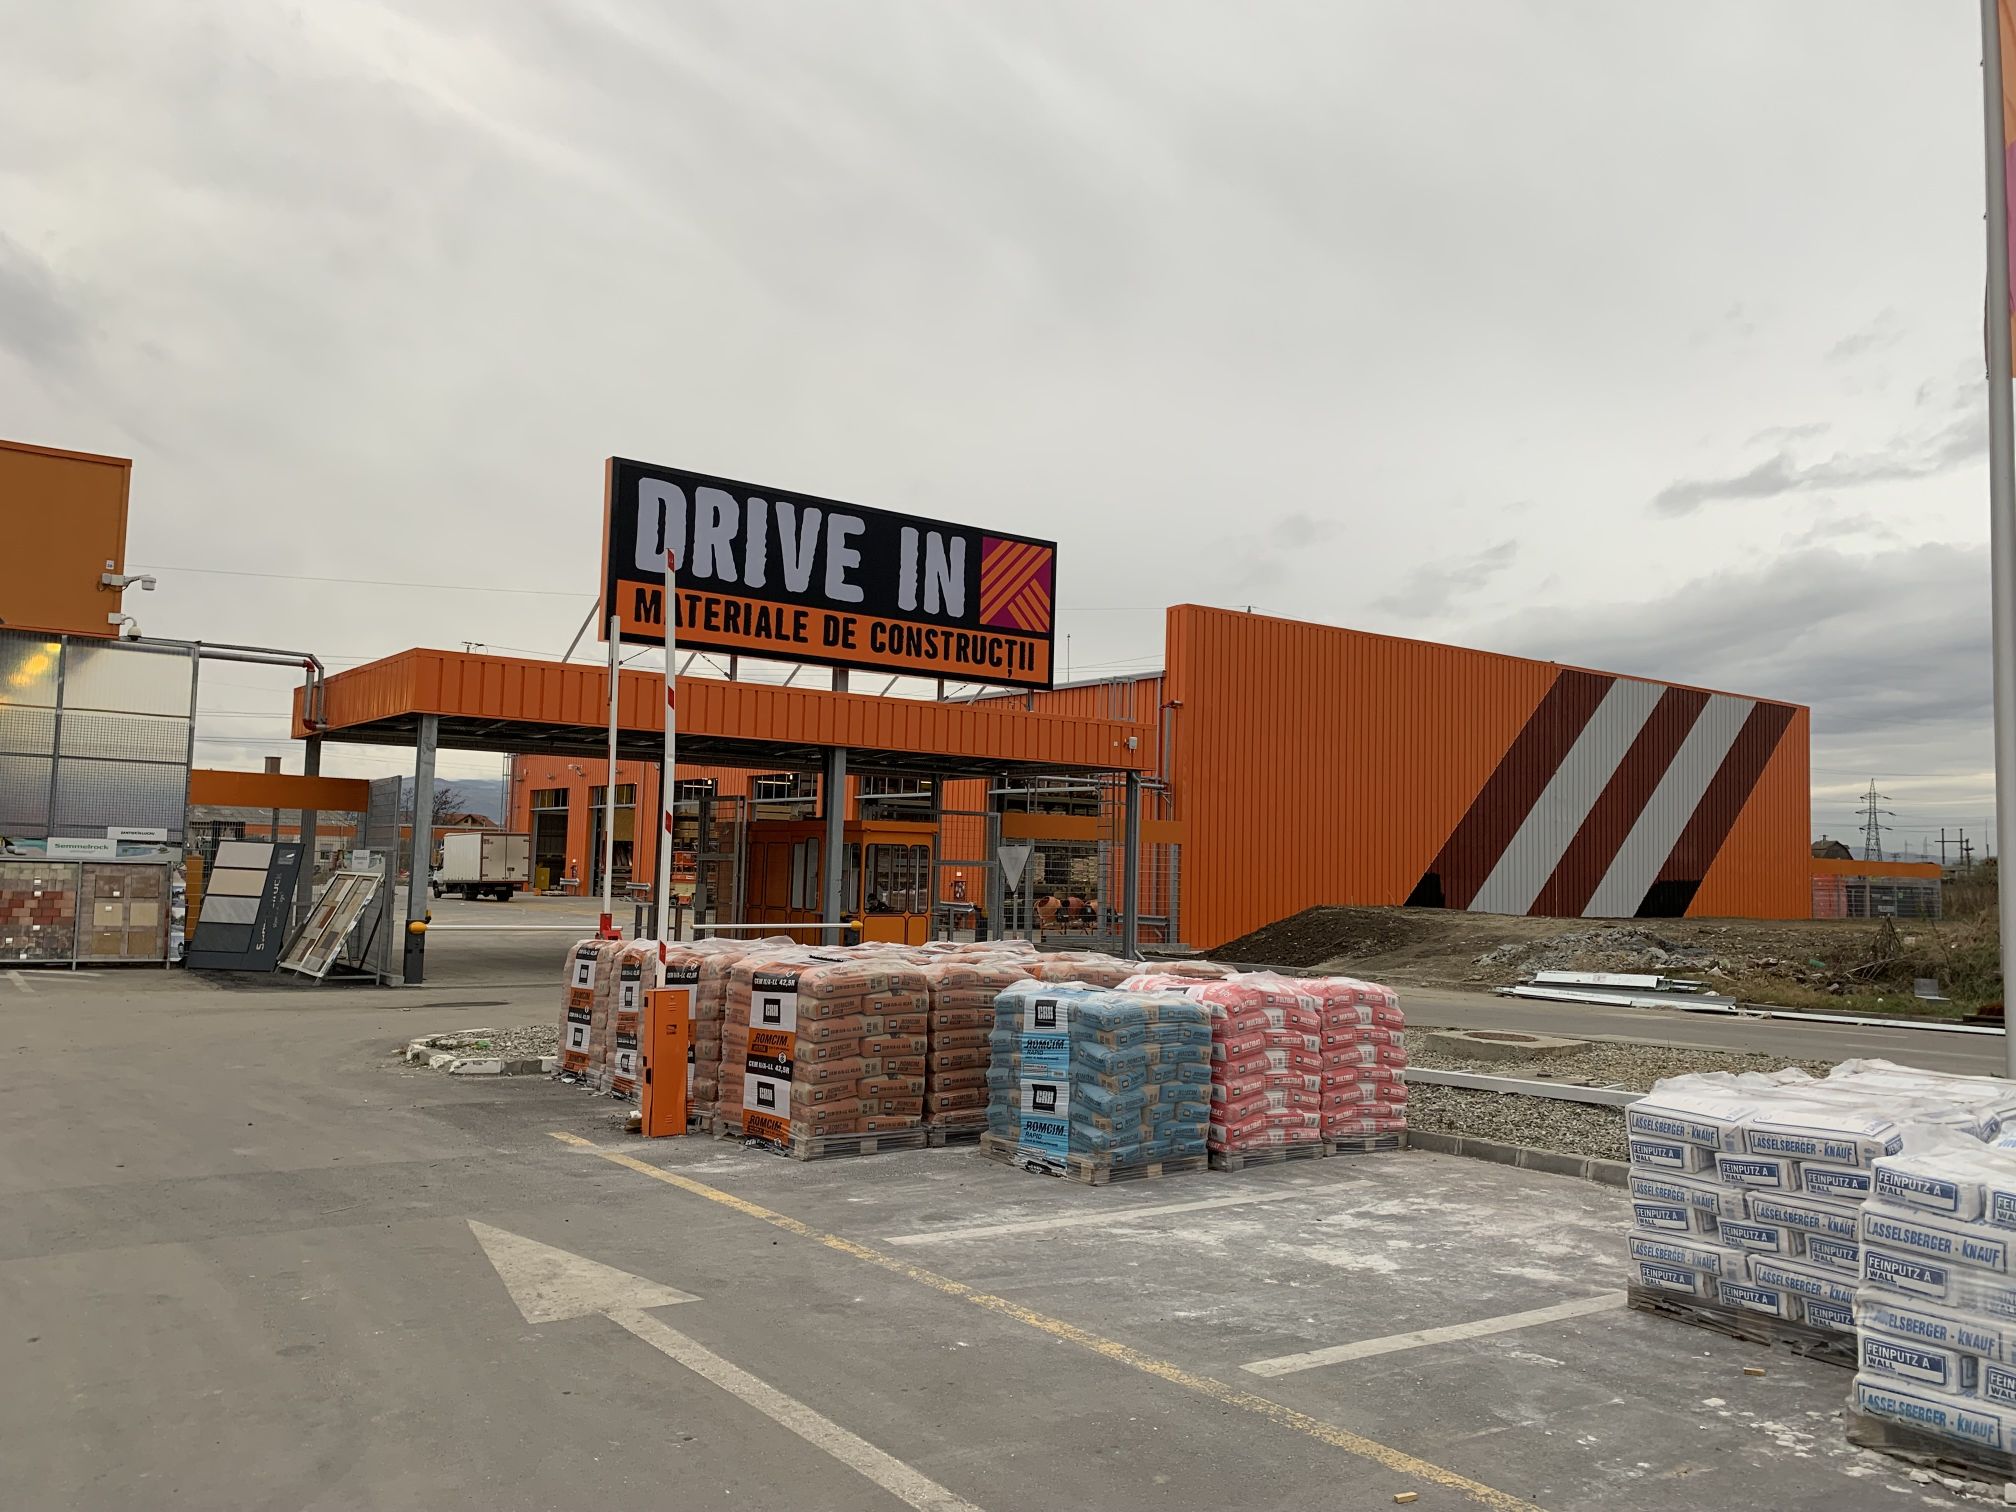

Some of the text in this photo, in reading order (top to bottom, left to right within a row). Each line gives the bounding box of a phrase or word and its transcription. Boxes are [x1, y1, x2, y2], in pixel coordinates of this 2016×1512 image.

[635, 477, 966, 618] DRIVE IN
[823, 615, 857, 649] DE
[871, 621, 1035, 678] CONSTRUCȚII
[1037, 1006, 1054, 1020] CRH
[774, 1065, 790, 1074] 42,5R
[1036, 1090, 1054, 1105] CRH
[1025, 1132, 1043, 1140] RAPID
[1632, 1114, 1715, 1145] LASSELSBERGER KNAUF
[1633, 1144, 1674, 1158] FEINPUTZ A
[1753, 1134, 1854, 1163] LASSELSBERGER KNAUF
[1722, 1164, 1768, 1176] FEINPUTZ A
[1808, 1174, 1859, 1189] FEINPUTZ A
[1878, 1171, 1942, 1196] FEINPUTZ A
[1633, 1180, 1715, 1211] LASSELSBERGER KNAUF
[1878, 1184, 1906, 1198] WALL
[1637, 1208, 1678, 1220] FEINPUTZ A
[1756, 1203, 1856, 1239] LASSELSBERGER KNAUF
[1723, 1225, 1768, 1241] FEINPUTZ A
[1867, 1217, 2000, 1268] LASSELSBERGER KNAUF
[1632, 1240, 1716, 1272] LASSELSBERGER KNAUF
[1812, 1244, 1854, 1261] FEINPUTZ
[1642, 1268, 1685, 1283] FEINPUTZ A
[1869, 1258, 1932, 1282] FEINPUTZ A
[1869, 1270, 1897, 1283] WALL
[1758, 1266, 1856, 1304] LASSELSBERGER KNAU
[1723, 1287, 1768, 1304] FEINPUTZ A
[1810, 1306, 1852, 1324] FEINPUTZ
[1958, 1327, 1996, 1356] KNAUF
[1867, 1343, 1931, 1369] FEINPUTZ A
[1867, 1356, 1896, 1370] WALL
[1990, 1372, 2016, 1390] FEIN
[1957, 1413, 1995, 1443] KNAUF
